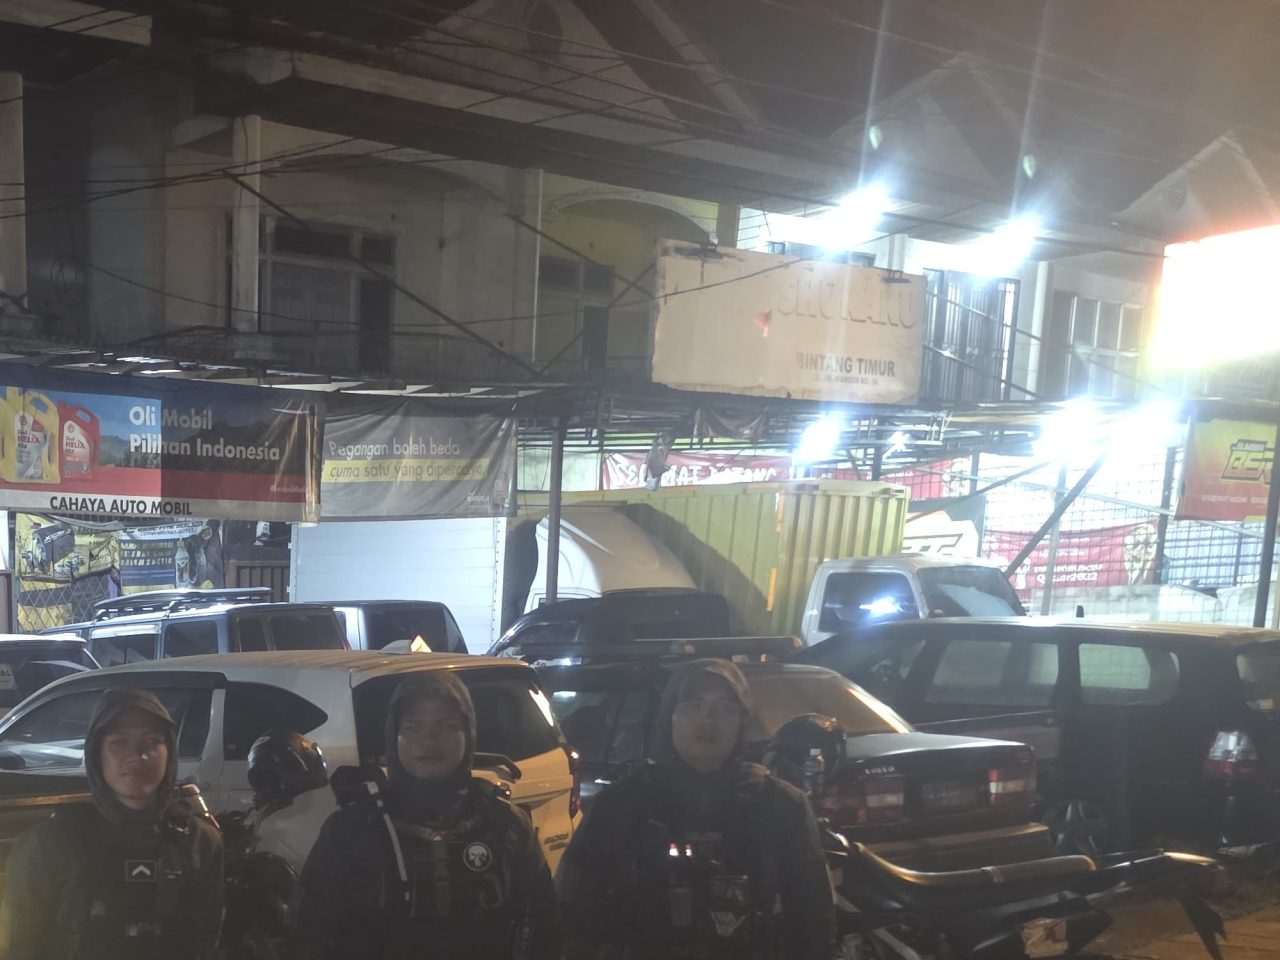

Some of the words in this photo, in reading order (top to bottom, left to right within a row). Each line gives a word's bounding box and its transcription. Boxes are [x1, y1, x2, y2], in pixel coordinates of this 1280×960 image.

[796, 352, 853, 374] BINTANG
[857, 358, 895, 377] TIMUR
[129, 406, 156, 426] Oli
[163, 408, 212, 430] Mobil
[130, 433, 190, 455] Pilihan
[197, 438, 279, 460] Indonesia
[329, 440, 389, 460] Pegangan
[393, 436, 426, 455] boleh
[430, 436, 460, 455] beda
[330, 466, 360, 479] cuma
[364, 464, 390, 477] satu
[394, 464, 423, 480] yang
[615, 462, 703, 486] SELMAT
[50, 496, 105, 512] CAHAYA
[111, 499, 147, 515] AUTO
[151, 501, 192, 516] MOBIL
